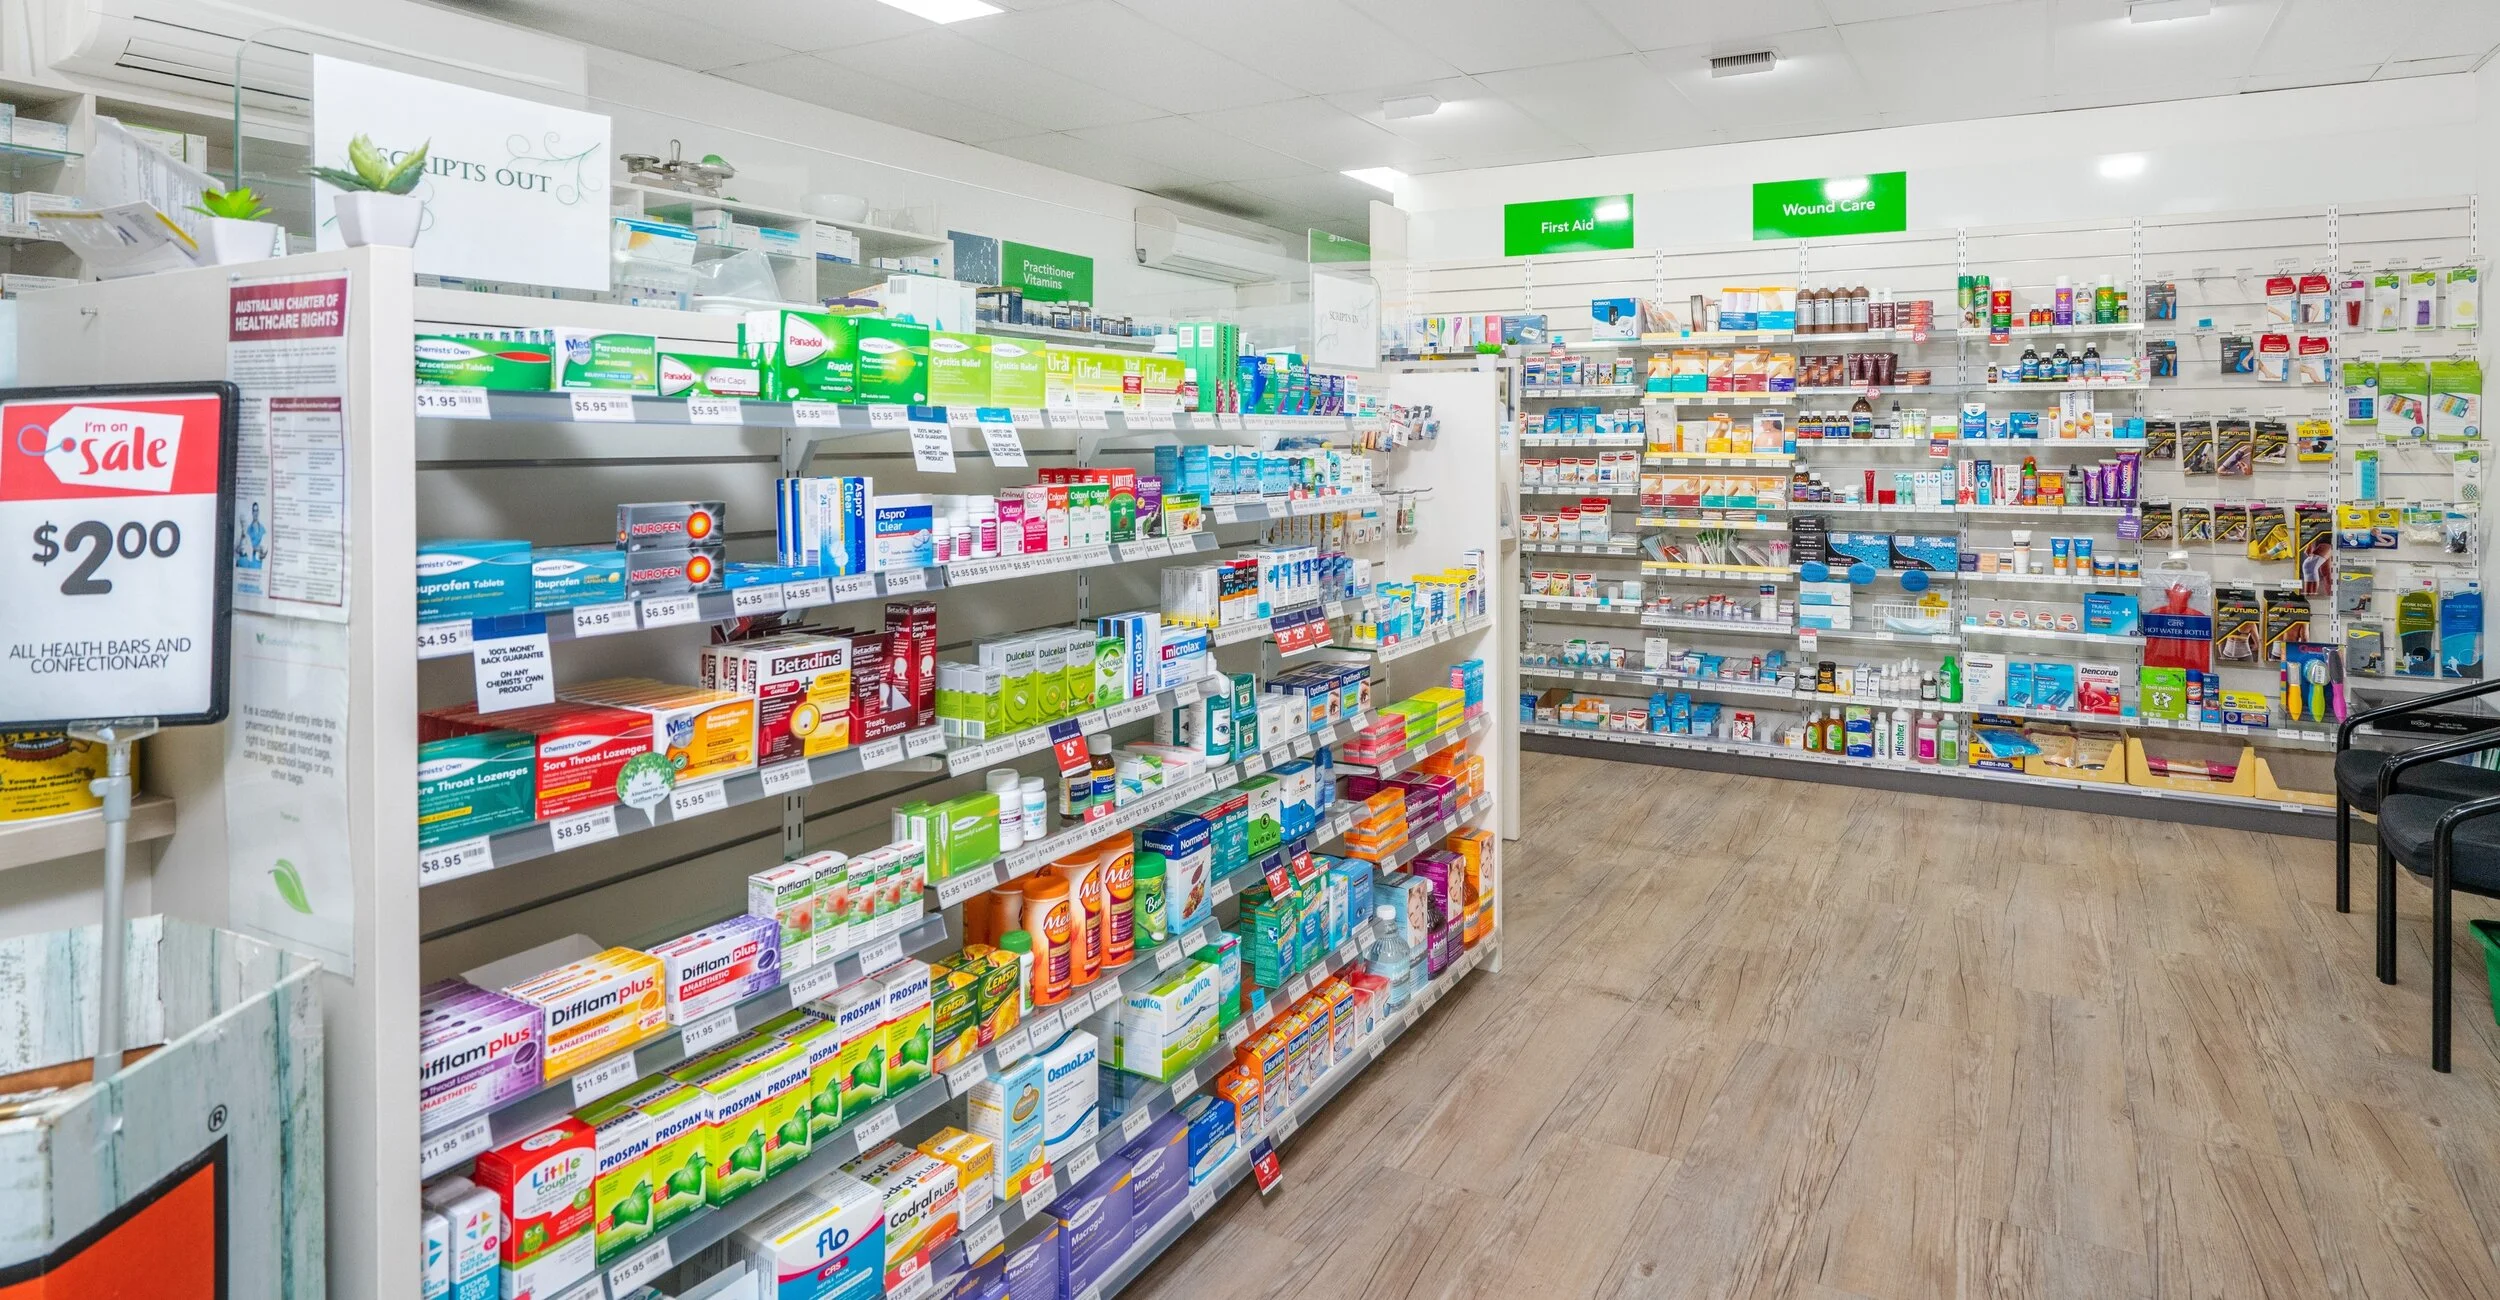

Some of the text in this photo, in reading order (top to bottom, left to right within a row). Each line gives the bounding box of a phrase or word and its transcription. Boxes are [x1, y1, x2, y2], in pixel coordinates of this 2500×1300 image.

[378, 147, 552, 194] SCIPTS OUT
[1782, 198, 1876, 217] Wound Care
[1541, 217, 1594, 234] First Aid
[1023, 260, 1075, 279] Practitioner
[1023, 272, 1062, 290] Vitamins
[236, 293, 339, 313] AUSTRALIAN CHARTER OF
[235, 311, 339, 331] HEALTHCARE RIGHTS
[565, 338, 590, 352] Med
[594, 343, 652, 355] Paracetamol
[789, 335, 822, 348] Panadol
[465, 362, 494, 373] Tablets
[827, 361, 853, 373] Rapid
[932, 356, 981, 369] Cystitis Relief
[1047, 351, 1070, 373] Ural
[1076, 359, 1102, 379] Ural
[663, 371, 692, 382] Panadol
[710, 376, 747, 386] Mini Caps
[1145, 364, 1167, 384] Ural
[417, 395, 457, 407] $1.95
[575, 401, 607, 412] $5.95
[692, 405, 719, 416] $5.95
[796, 409, 820, 419] $6.95
[84, 421, 129, 433] I'm on
[79, 426, 169, 476] sale
[843, 482, 853, 514] Clear
[854, 482, 864, 517] Aspro
[878, 508, 905, 522] Aspro
[631, 521, 682, 535] NUROFEN
[878, 520, 903, 533] Clear
[631, 566, 682, 581] NUROFEN
[417, 577, 505, 594] uprofen Tablets
[535, 577, 580, 590] Ibuprofen
[736, 594, 763, 607] $4.95
[645, 605, 675, 619] $6.95
[912, 604, 936, 616] Betadine
[577, 613, 610, 627] $4.95
[2167, 619, 2184, 627] care
[417, 632, 457, 648] $4.95
[2160, 627, 2183, 636] WATER
[2184, 628, 2211, 638] BOTTLE
[8, 638, 192, 659] ALL HEALTH BARS AND
[488, 644, 535, 656] 100% MONEY
[1165, 641, 1200, 659] microlax
[30, 653, 171, 674] CONFECTIONARY
[481, 651, 545, 665] BACK GUARANTEE
[775, 652, 842, 674] Betadine
[1132, 631, 1144, 693] microlax
[500, 668, 529, 679] ON ANY
[2080, 667, 2119, 677] Dencorub
[485, 674, 545, 689] CHEMISTS' OWN
[498, 683, 533, 695] PRODUCT
[1309, 681, 1329, 696] Optifresh
[260, 708, 286, 720] condition
[295, 715, 309, 727] entry
[865, 717, 886, 729] Treats
[245, 720, 274, 736] pharmacy
[298, 730, 321, 741] reserve
[865, 721, 907, 738] Sore Throats
[543, 739, 592, 754] Chemists' Own
[908, 737, 929, 749] $13.95
[543, 743, 647, 772] Sore Throat Lozenges
[862, 749, 886, 761] $12.95
[418, 766, 528, 796] ore Throat Lozenges
[764, 772, 790, 786] $19.95
[675, 796, 705, 812] $5.95
[556, 822, 591, 841] $8.95
[1180, 828, 1211, 850] Normacol
[815, 863, 847, 880] Difflam
[682, 941, 758, 982] Difflam plus
[682, 969, 730, 994] ANAESTHETIC
[792, 979, 818, 997] $15.95
[552, 975, 655, 1027] Difflam plus
[487, 1026, 531, 1059] plus
[685, 1025, 714, 1044] $11.95
[1047, 1047, 1096, 1085] OsmoLax
[429, 1063, 495, 1095] Throat Lozenges
[576, 1071, 609, 1093] $11.95
[767, 1067, 808, 1096] PROSPAN
[719, 1089, 762, 1120] PROSPAN
[654, 1110, 703, 1143] PROSPAN
[857, 1121, 881, 1142] $21.95
[966, 1151, 993, 1173] Coloxyl
[531, 1154, 582, 1190] Little
[1133, 1162, 1166, 1193] Macrogol
[536, 1170, 579, 1197] Coughs
[889, 1178, 956, 1229] Codral PLUS
[1071, 1212, 1106, 1247] Macrogol
[815, 1226, 850, 1259] flo
[967, 1233, 988, 1254] $10.95
[460, 1252, 498, 1275] DEFENCE
[459, 1273, 489, 1294] STOPS
[612, 1262, 645, 1287] $15.95
